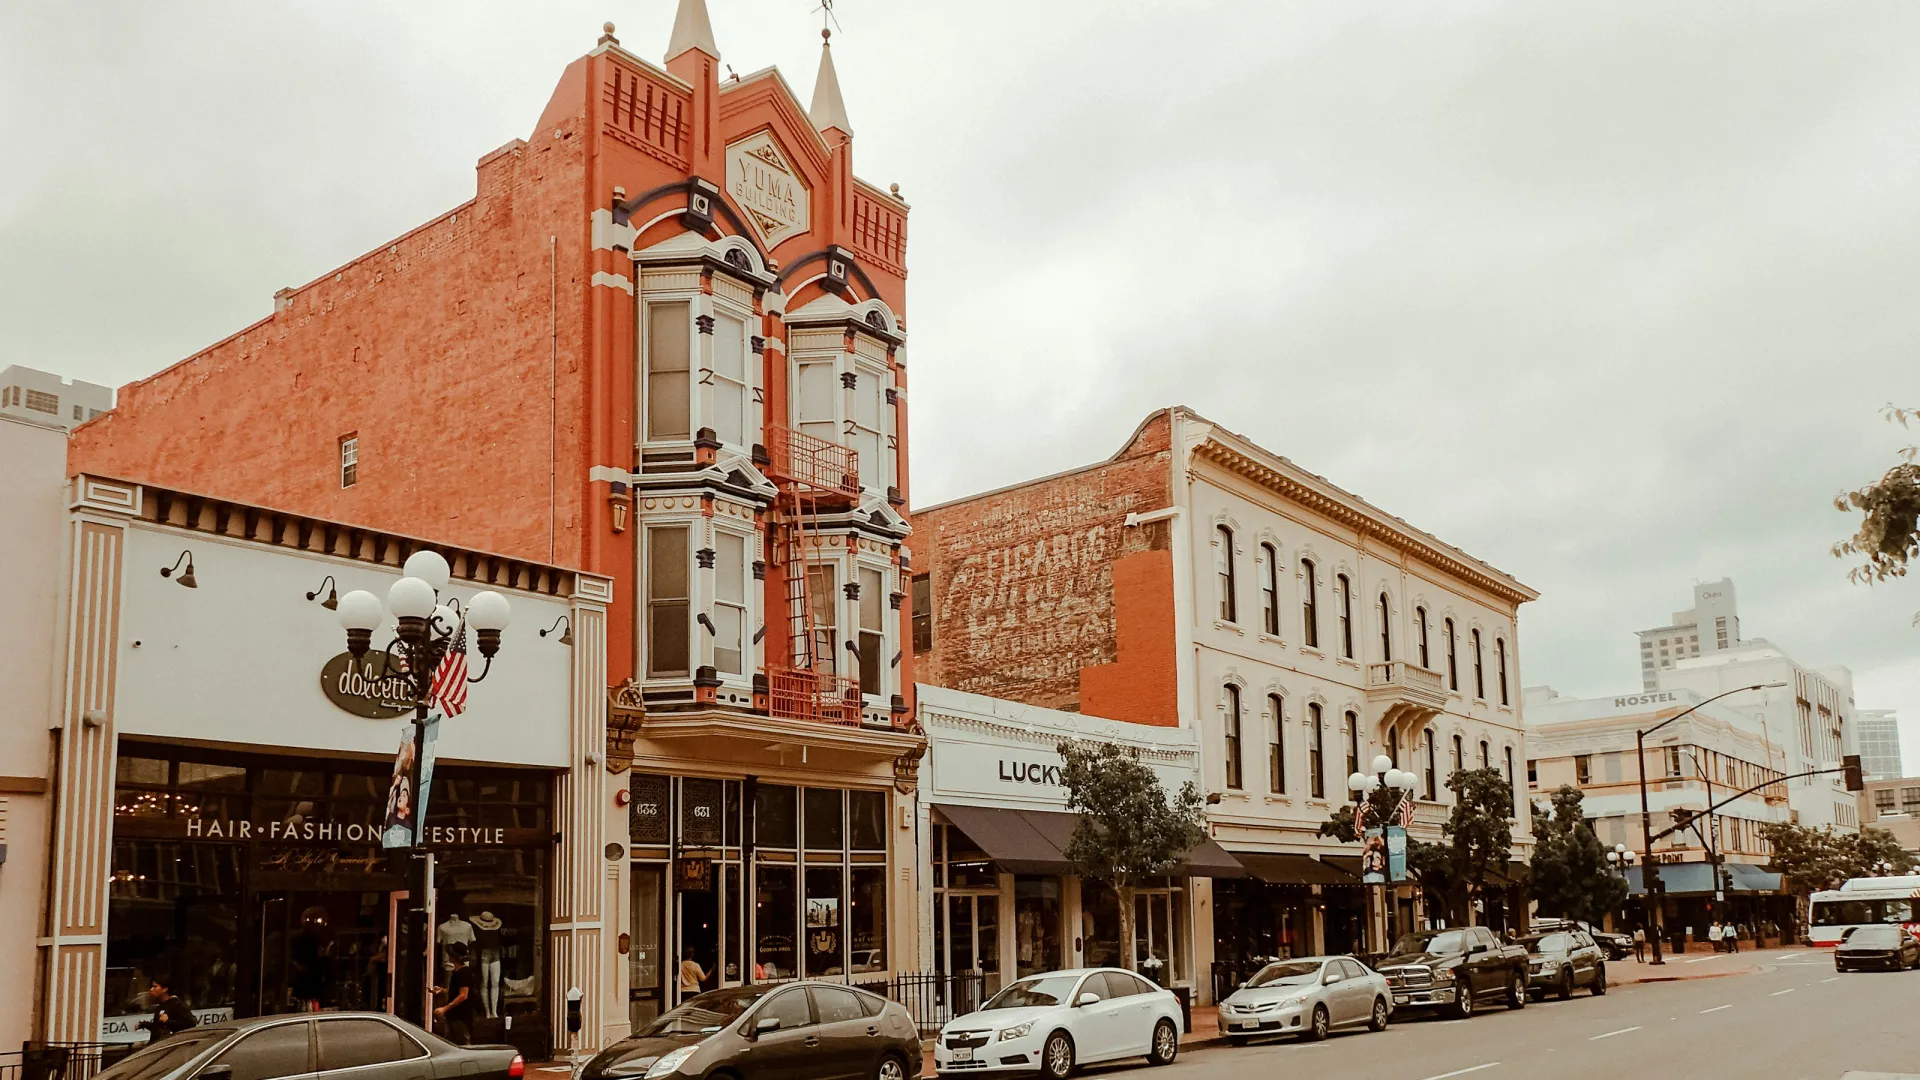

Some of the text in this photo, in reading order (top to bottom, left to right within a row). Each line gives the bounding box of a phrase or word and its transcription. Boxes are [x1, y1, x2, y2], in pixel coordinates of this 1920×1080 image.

[738, 158, 795, 206] YUMA
[1614, 692, 1677, 708] HOSTEL
[636, 803, 657, 816] 633
[694, 806, 710, 818] 631
[187, 818, 504, 844] HAIR FASHION ESTYLE
[102, 1022, 129, 1035] EDA
